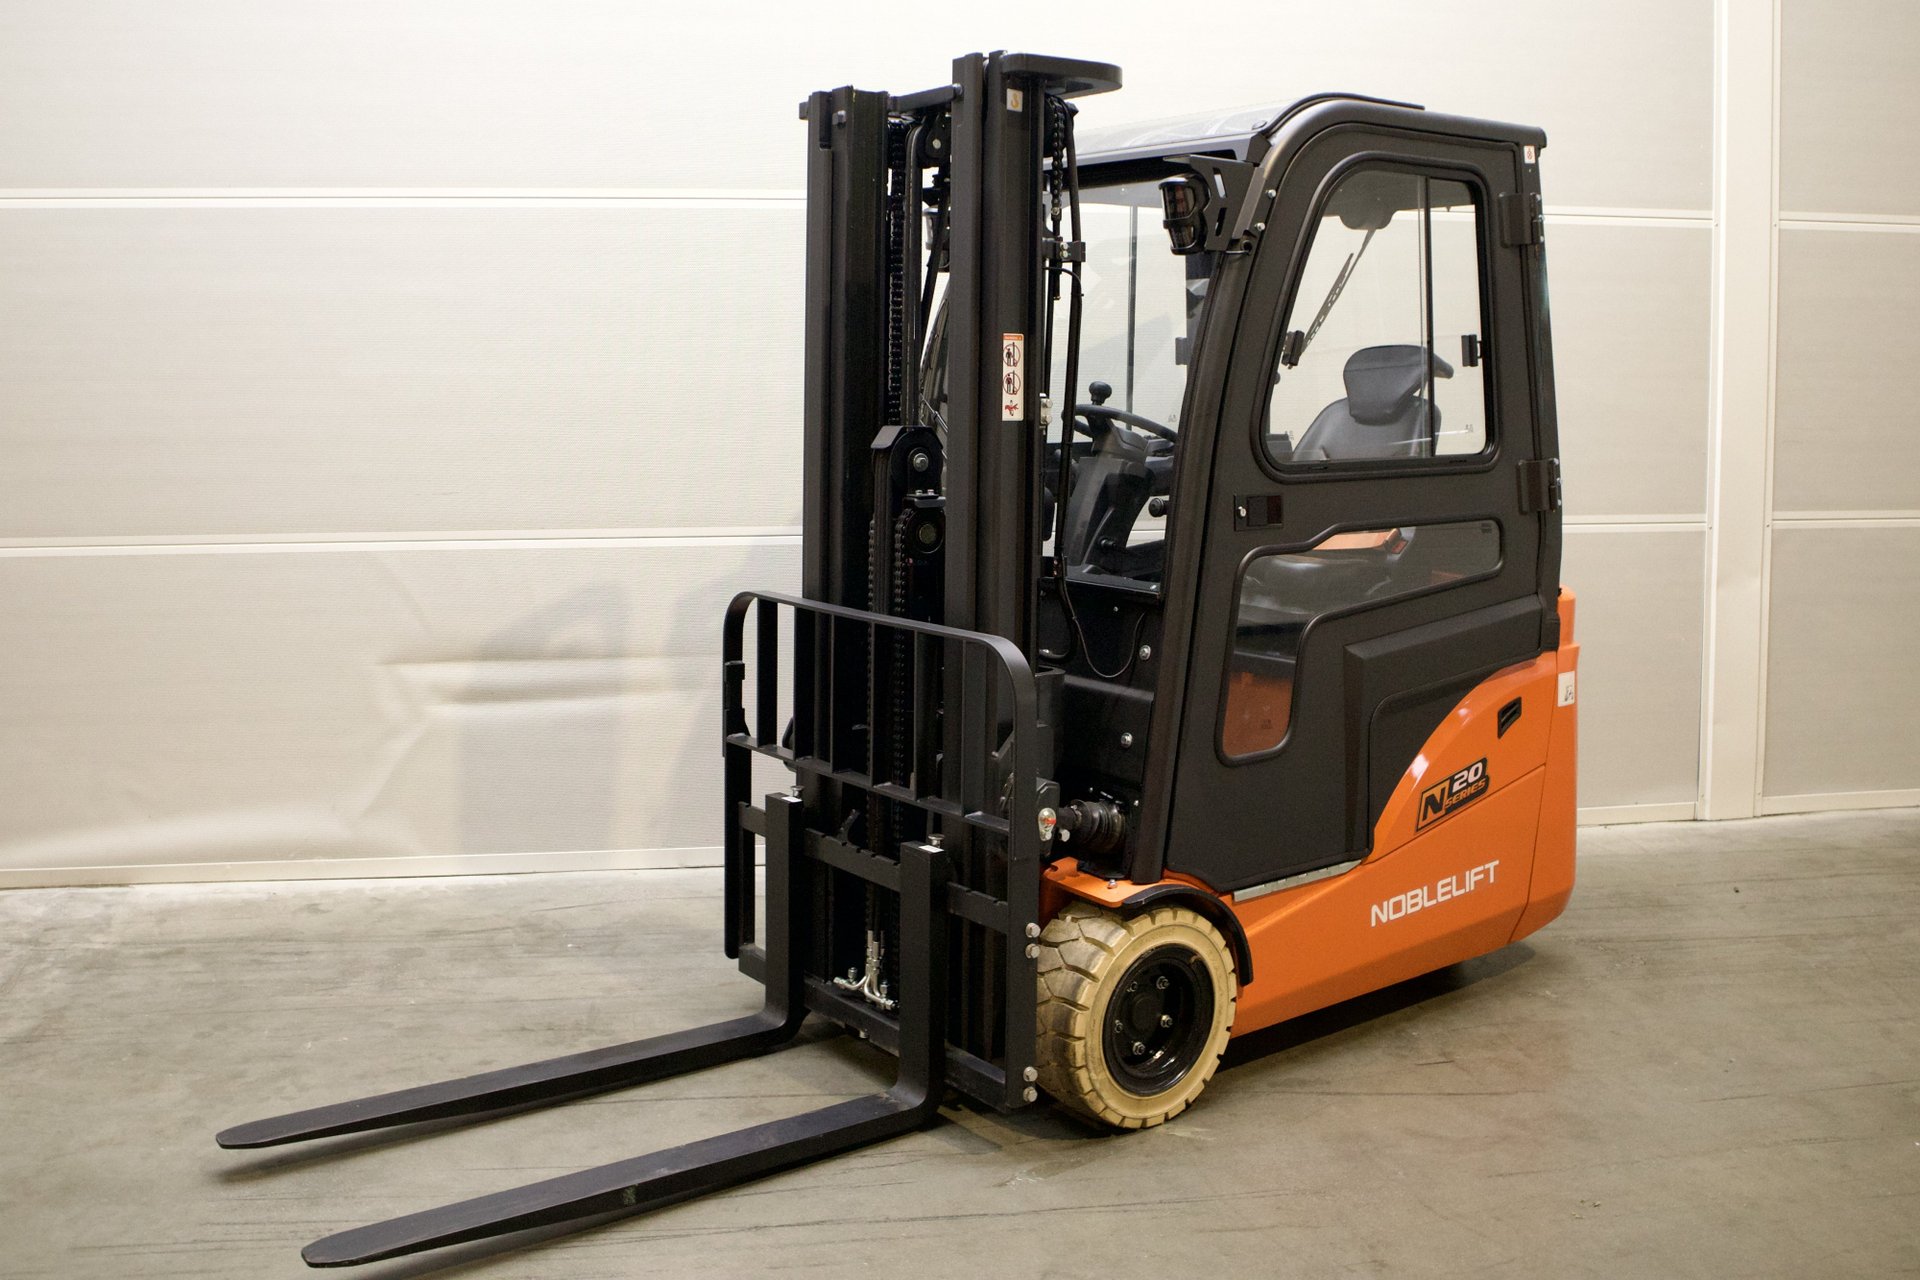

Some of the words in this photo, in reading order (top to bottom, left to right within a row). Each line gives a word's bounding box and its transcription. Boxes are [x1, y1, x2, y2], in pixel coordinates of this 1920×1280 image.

[1422, 787, 1445, 822] N
[1452, 762, 1483, 793] 20
[1445, 778, 1486, 808] SERIES
[1371, 860, 1499, 927] NOBLELIFT
